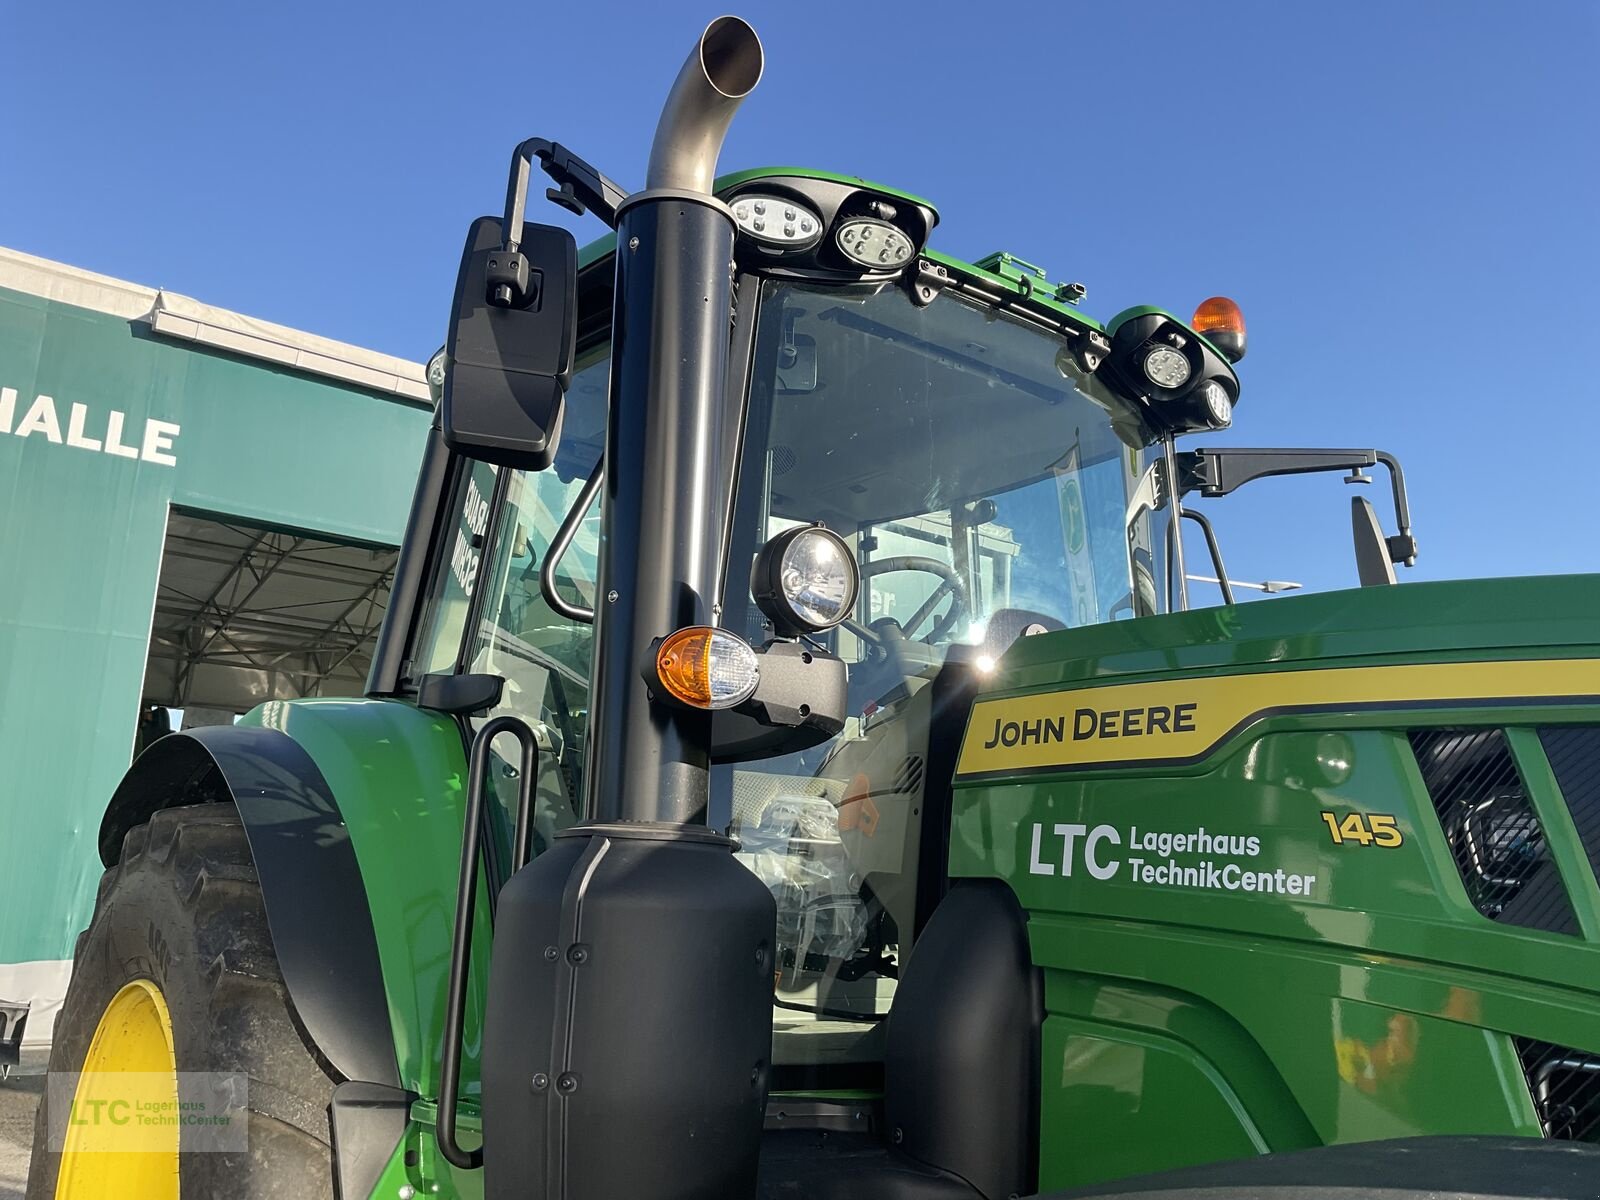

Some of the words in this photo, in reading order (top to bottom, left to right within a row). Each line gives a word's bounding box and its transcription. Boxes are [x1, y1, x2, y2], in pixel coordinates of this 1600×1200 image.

[984, 717, 1065, 750] JOHN
[1073, 703, 1199, 742] DEERE
[1129, 826, 1261, 857] Lagerhaus
[1321, 810, 1404, 849] 145
[1029, 823, 1122, 881] LTC
[1128, 857, 1316, 897] TechnikCenter
